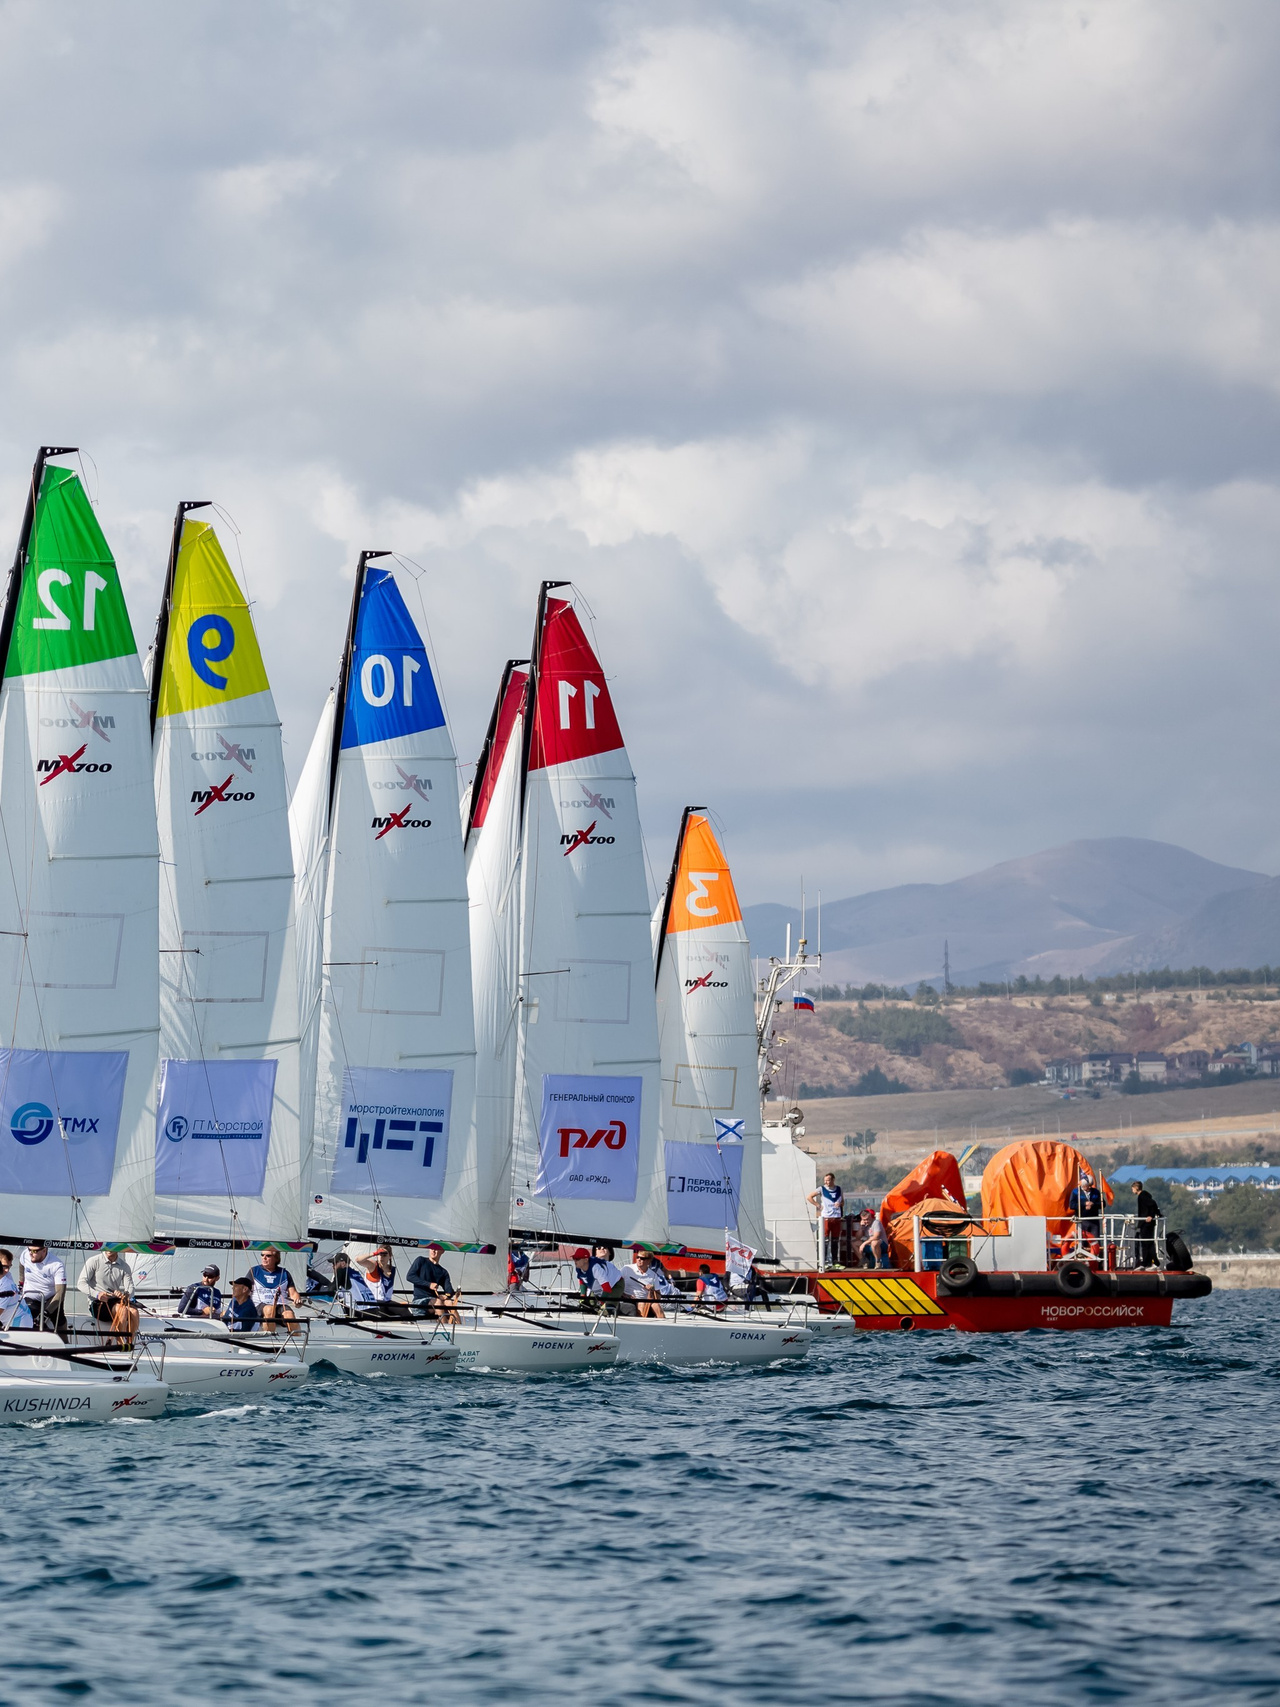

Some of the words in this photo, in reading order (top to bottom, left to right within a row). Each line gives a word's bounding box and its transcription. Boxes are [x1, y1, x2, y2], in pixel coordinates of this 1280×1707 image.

[36, 743, 113, 786] MX700
[191, 773, 255, 816] MX700
[371, 803, 432, 840] MX700
[560, 820, 615, 857] MX700
[685, 970, 728, 995] MX700
[549, 1093, 605, 1102] ГЕНЕРАЛЬНЫЙ
[606, 1095, 635, 1103] СПОНСОР
[349, 1104, 445, 1117] морстройтехнология
[193, 1120, 205, 1130] ГТ
[207, 1119, 264, 1133] Морстрой
[569, 1174, 584, 1182] ОАО
[687, 1178, 721, 1187] ПЕРВАЯ
[687, 1185, 733, 1195] ПОРТОВАЯ
[1041, 1304, 1144, 1316] НОВОРОССИЙСК
[730, 1332, 766, 1340] FORNAX
[371, 1353, 415, 1361] PROXIMA
[220, 1369, 255, 1377] CETUS
[3, 1396, 92, 1413] KUSHINDA
